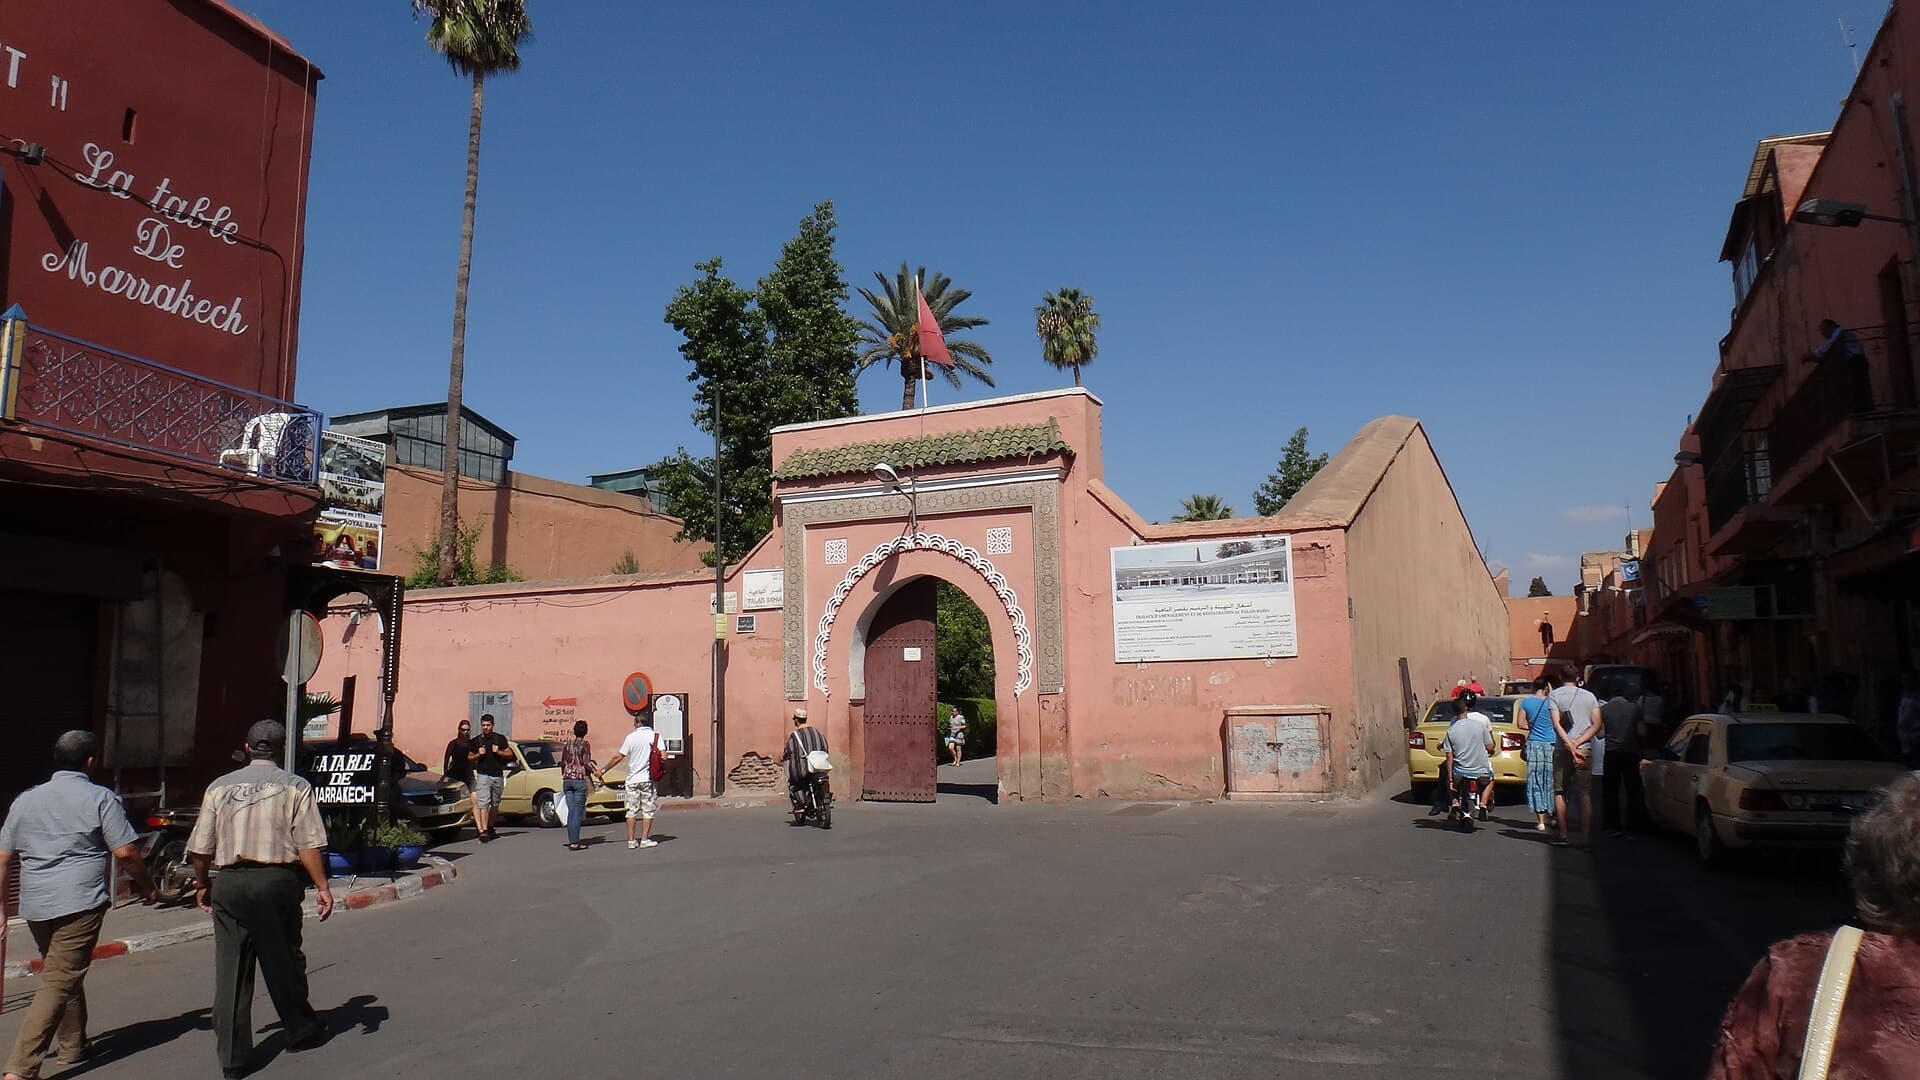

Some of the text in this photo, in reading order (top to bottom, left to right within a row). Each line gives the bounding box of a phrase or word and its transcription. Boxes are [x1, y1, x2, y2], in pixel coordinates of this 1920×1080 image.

[75, 142, 240, 245] La table
[132, 217, 185, 269] De
[41, 238, 248, 336] Marrakech
[328, 753, 375, 772] TABLE
[328, 772, 354, 786] DE
